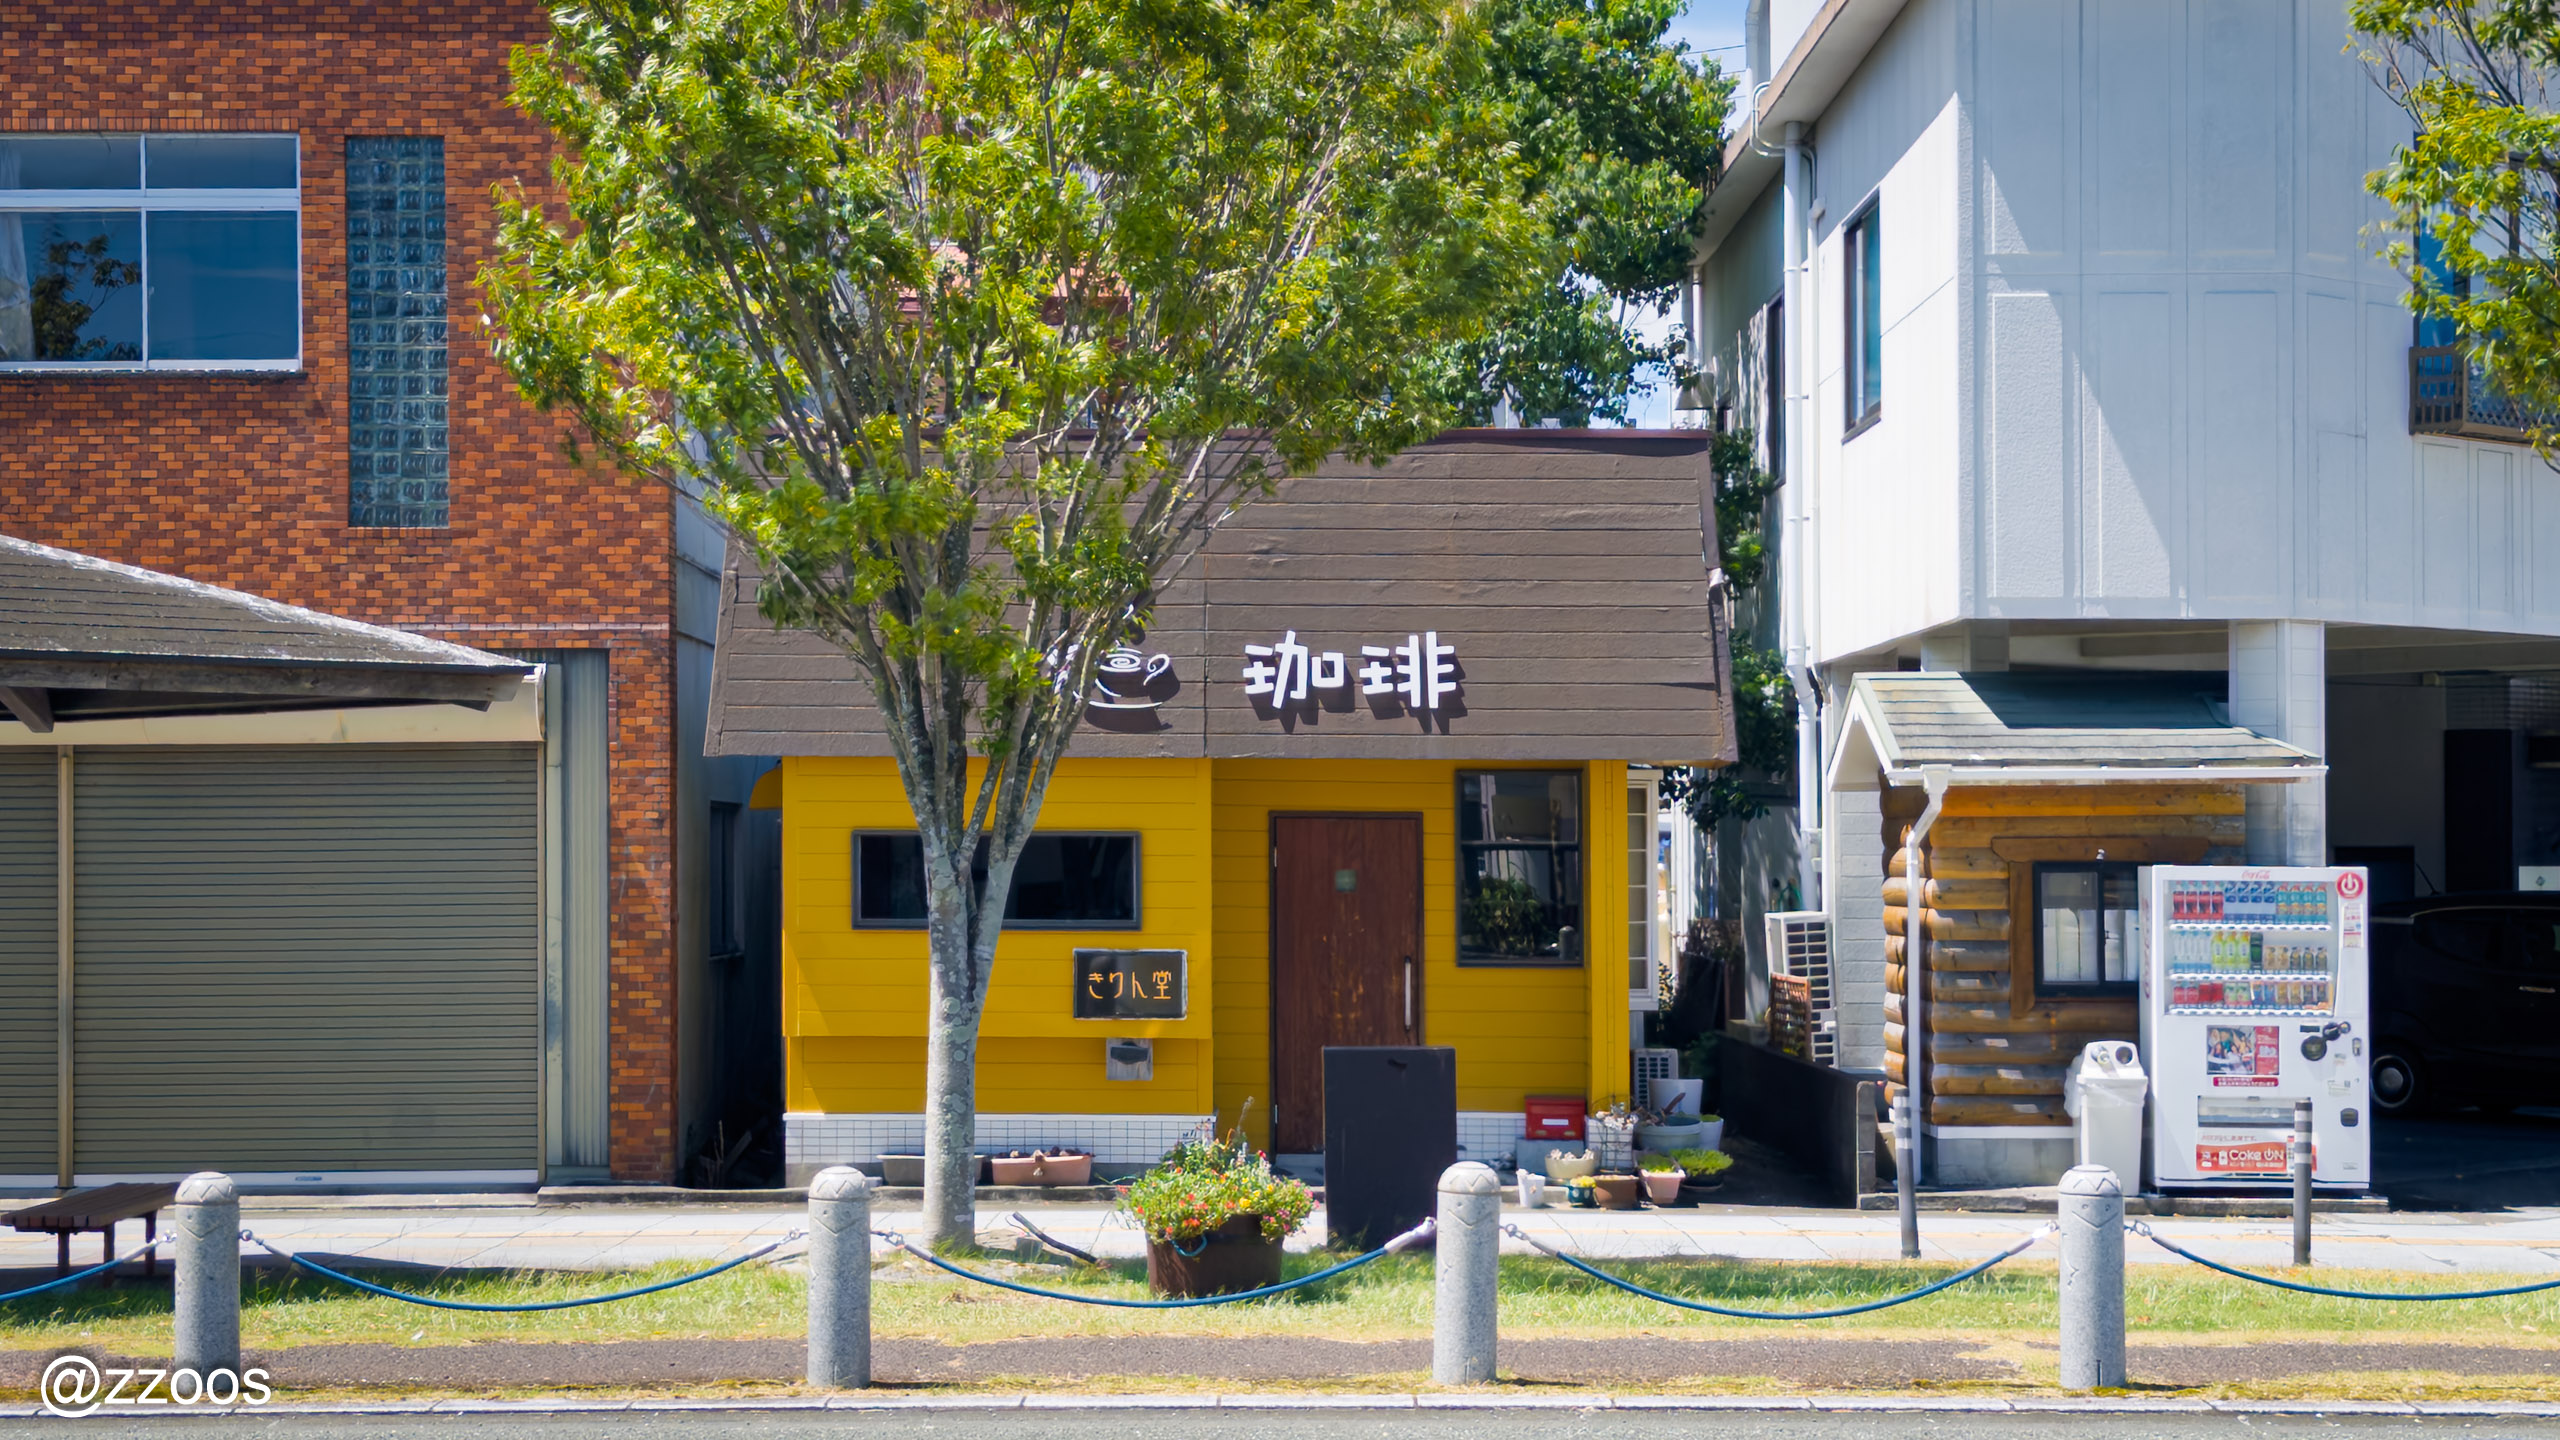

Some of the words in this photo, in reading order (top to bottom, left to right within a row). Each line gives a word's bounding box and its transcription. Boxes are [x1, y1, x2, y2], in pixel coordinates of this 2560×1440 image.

[1242, 630, 1457, 709] 珈琲
[1088, 970, 1172, 999] きりん堂
[2229, 1149, 2261, 1161] Coke
